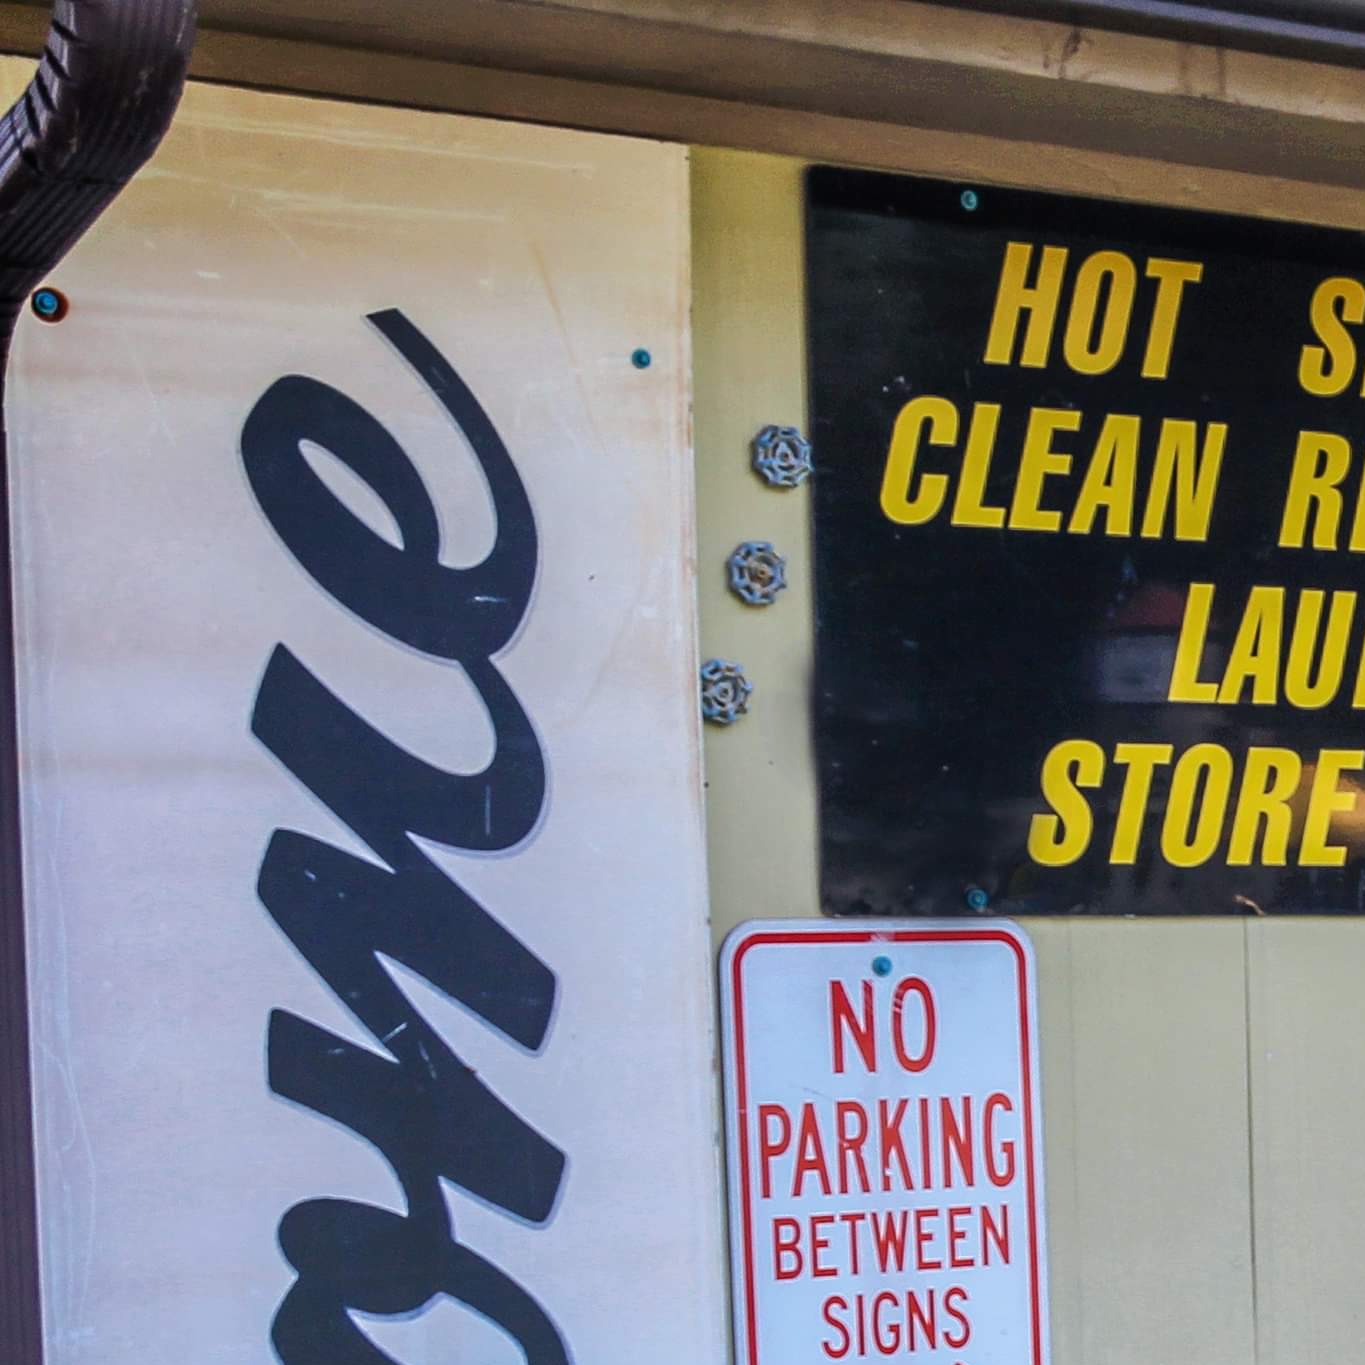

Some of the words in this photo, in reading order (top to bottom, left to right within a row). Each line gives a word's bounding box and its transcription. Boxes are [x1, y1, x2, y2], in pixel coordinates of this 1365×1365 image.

[983, 242, 1203, 379] HOT
[879, 396, 1228, 541] CLEAN
[1028, 739, 1365, 867] STORE
[829, 976, 937, 1074] NO
[758, 1092, 1016, 1199] PARKING
[772, 1204, 1011, 1281] BETWEEN
[822, 1287, 972, 1359] SIGNS
